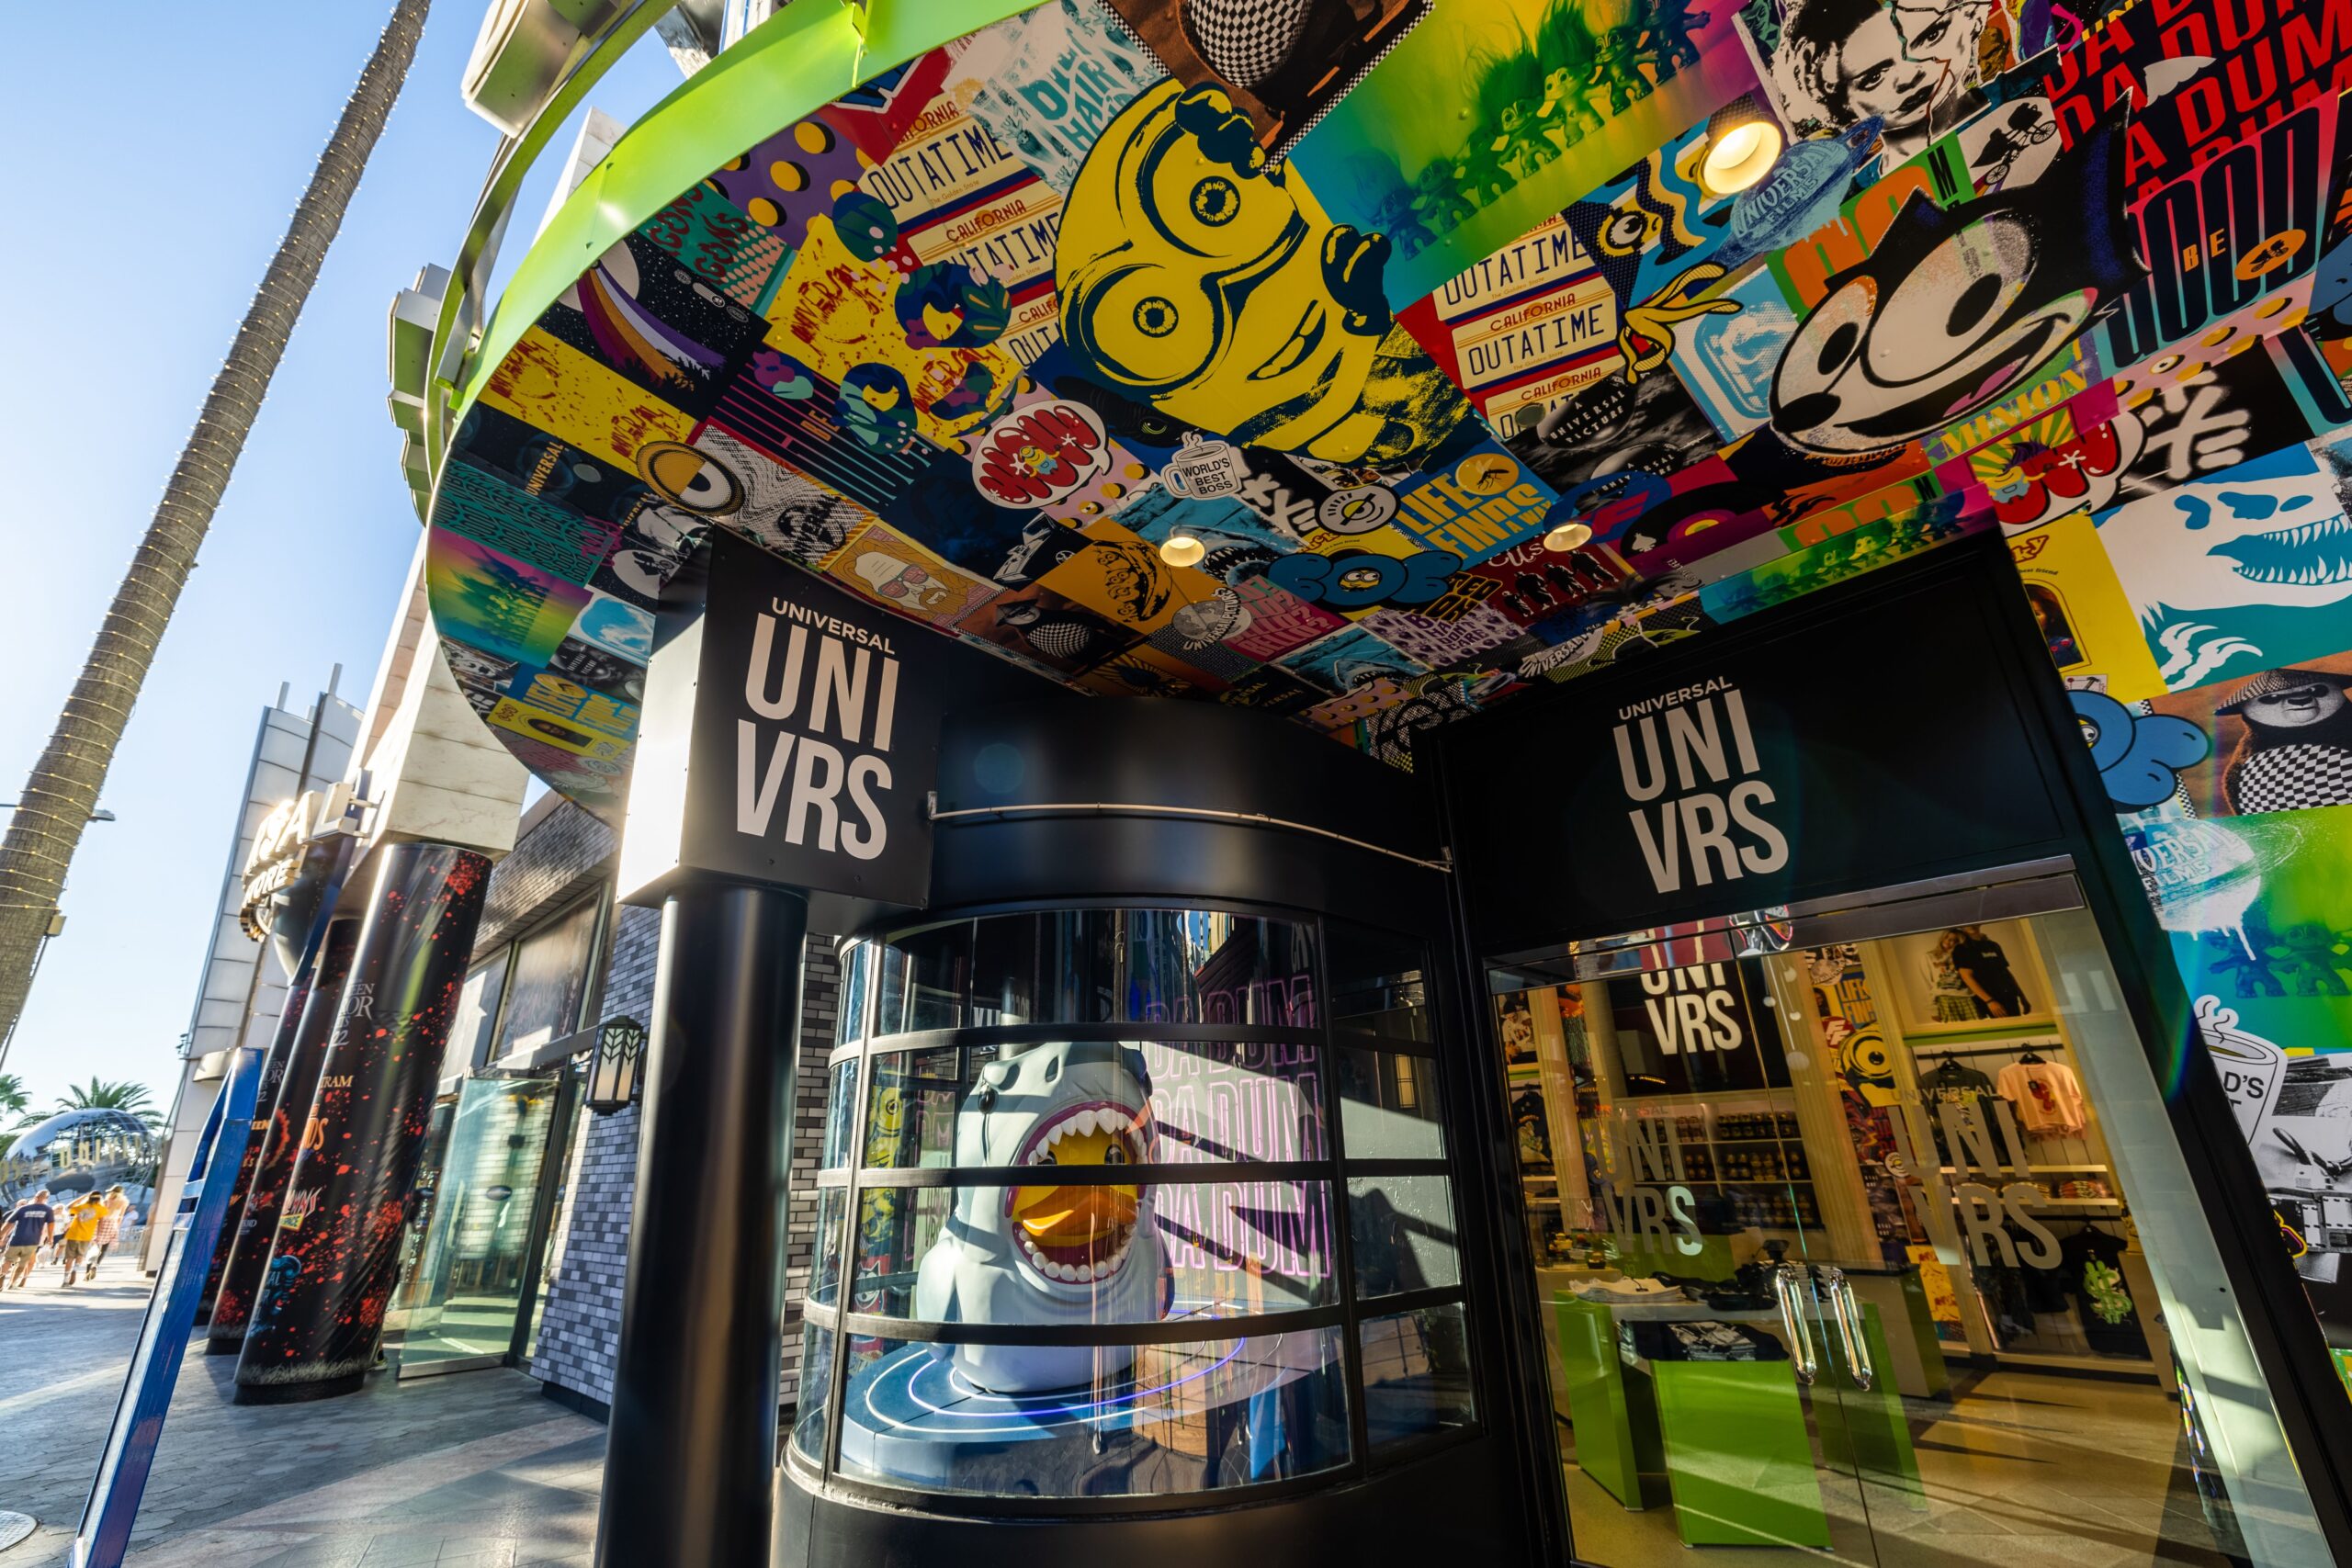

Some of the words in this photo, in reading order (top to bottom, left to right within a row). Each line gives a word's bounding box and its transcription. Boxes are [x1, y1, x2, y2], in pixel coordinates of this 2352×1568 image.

[868, 124, 1014, 209] OUTATIME
[945, 199, 1027, 242] CALIFORNIA
[1766, 177, 1819, 224] FILMS
[1469, 304, 1606, 377] OUTATIME
[1490, 293, 1577, 332] CALIFORNIA
[1521, 367, 1602, 401] CALIFORNIA
[1549, 389, 1626, 440] UNIVERSAL
[1940, 364, 2089, 459] MINION
[1565, 404, 1624, 444] PICTURE
[524, 441, 565, 497] UNIVERSAL
[1182, 457, 1231, 478] WORLD'S
[1195, 470, 1227, 487] BEST
[1198, 479, 1234, 496] BOSS
[1396, 472, 1484, 536] LIFE
[1426, 482, 1545, 560] FINDS
[771, 597, 896, 655] UNIVERSAL
[745, 612, 900, 752] UNI
[1618, 675, 1733, 721] UNIVERSAL
[1612, 689, 1761, 802] UNI
[737, 718, 893, 861] VRS
[1628, 780, 1790, 895] VRS
[1644, 988, 1743, 1056] VRS
[1886, 1101, 2030, 1179] UNI
[1600, 1185, 1702, 1256] VRS
[1905, 1180, 2064, 1270] VRS
